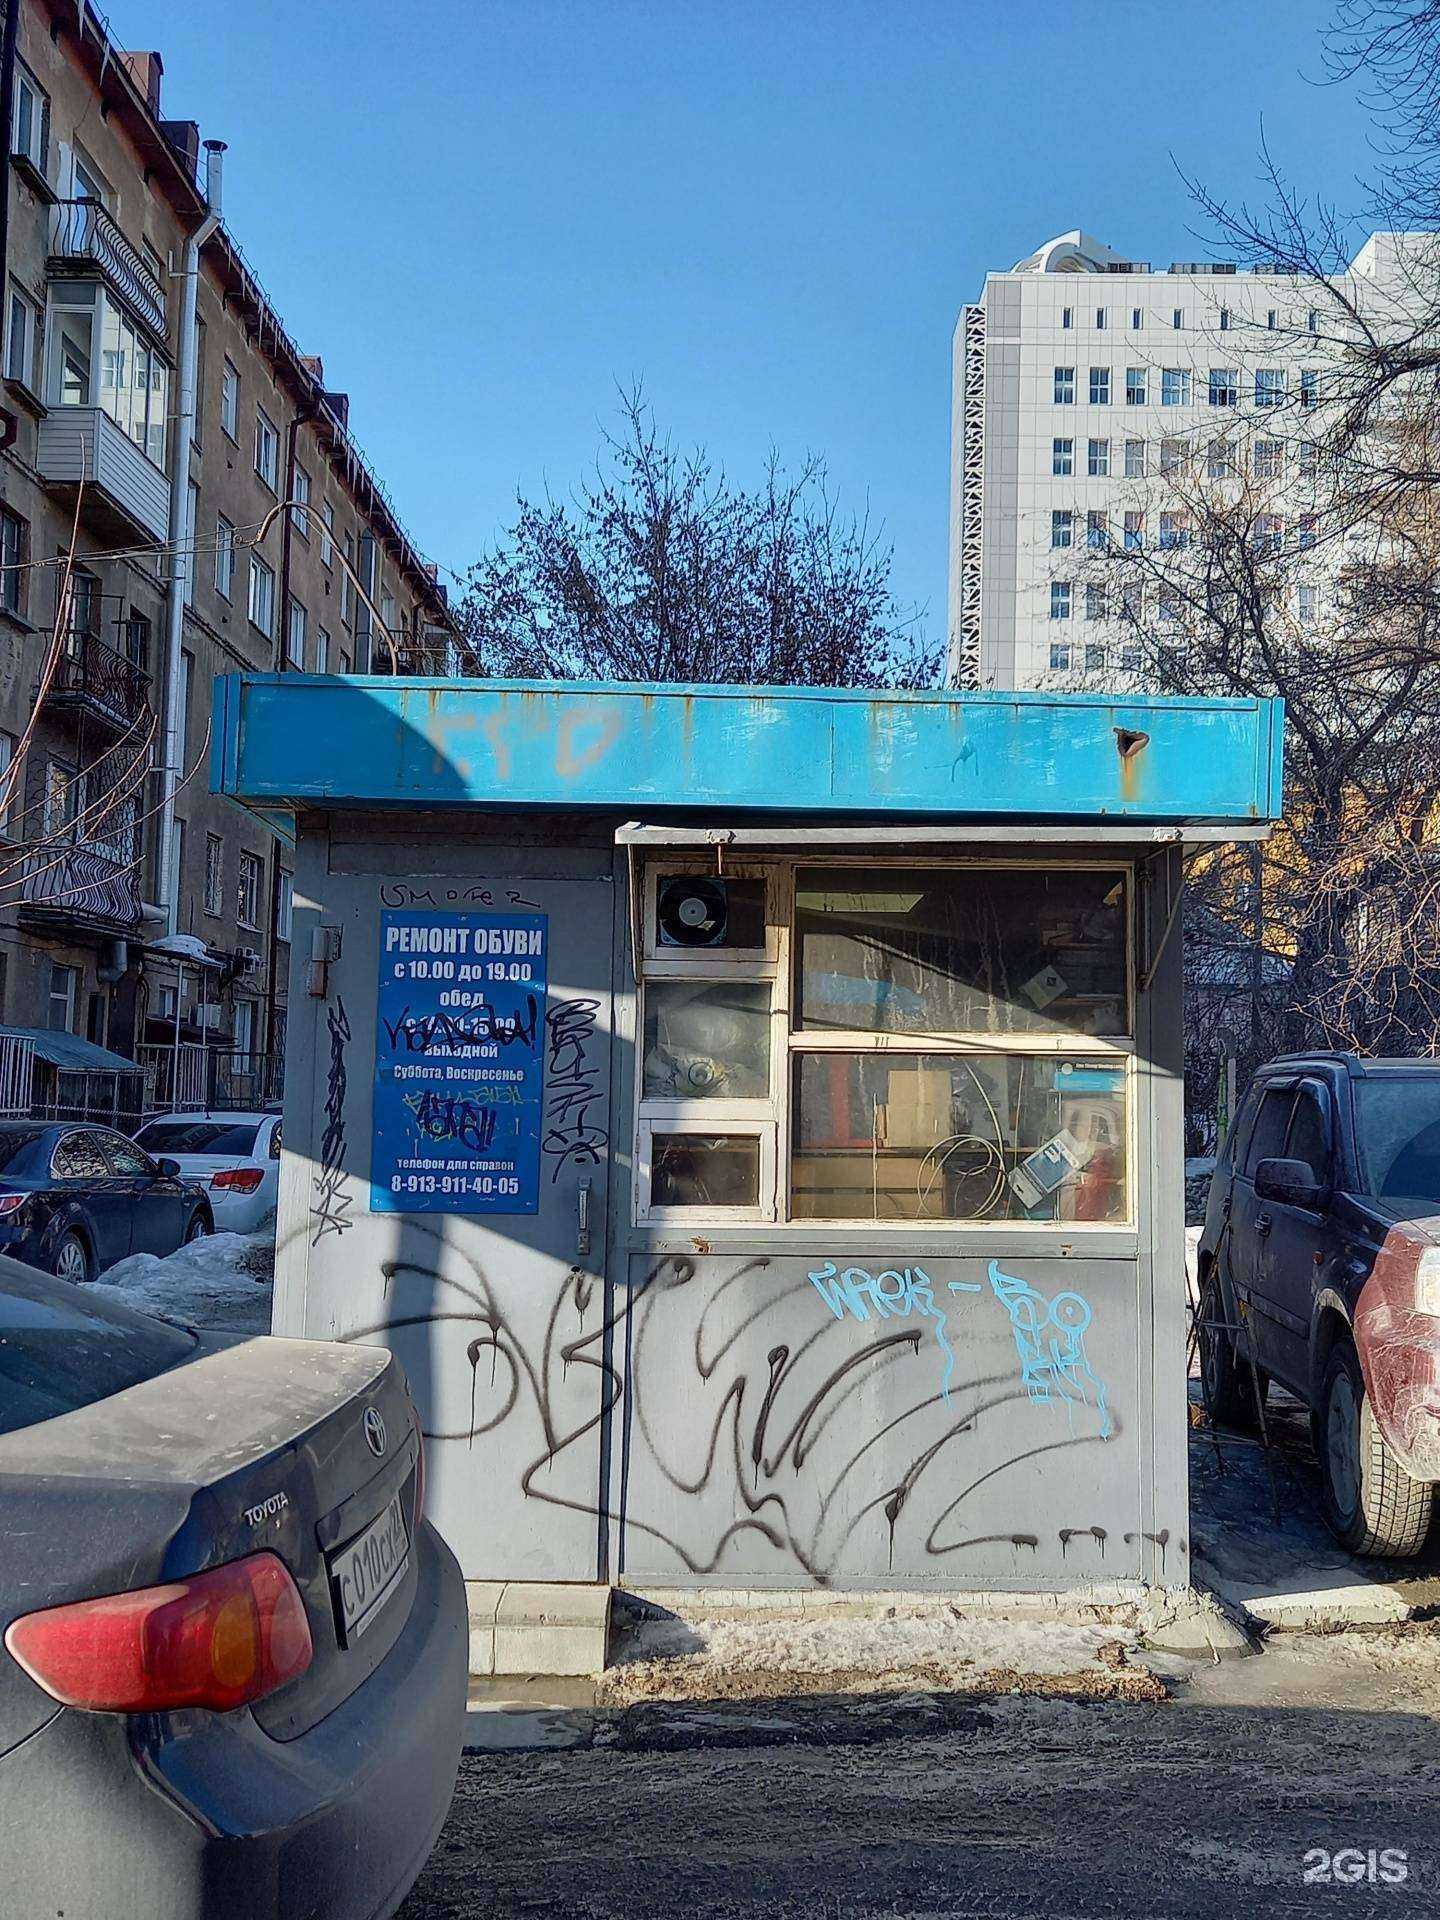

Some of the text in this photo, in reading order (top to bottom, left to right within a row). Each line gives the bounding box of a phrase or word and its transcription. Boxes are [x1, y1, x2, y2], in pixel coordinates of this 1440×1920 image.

[386, 927, 543, 956] РЕМОНТ ОБУВИ
[394, 961, 532, 981] с 10.00 до 19.00
[440, 989, 484, 1009] обед
[394, 1065, 524, 1081] Суббота, Воскресенье
[397, 1159, 445, 1170] телефон
[391, 1175, 519, 1195] 8-913-911-40-05
[244, 1492, 289, 1526] TOYOTA
